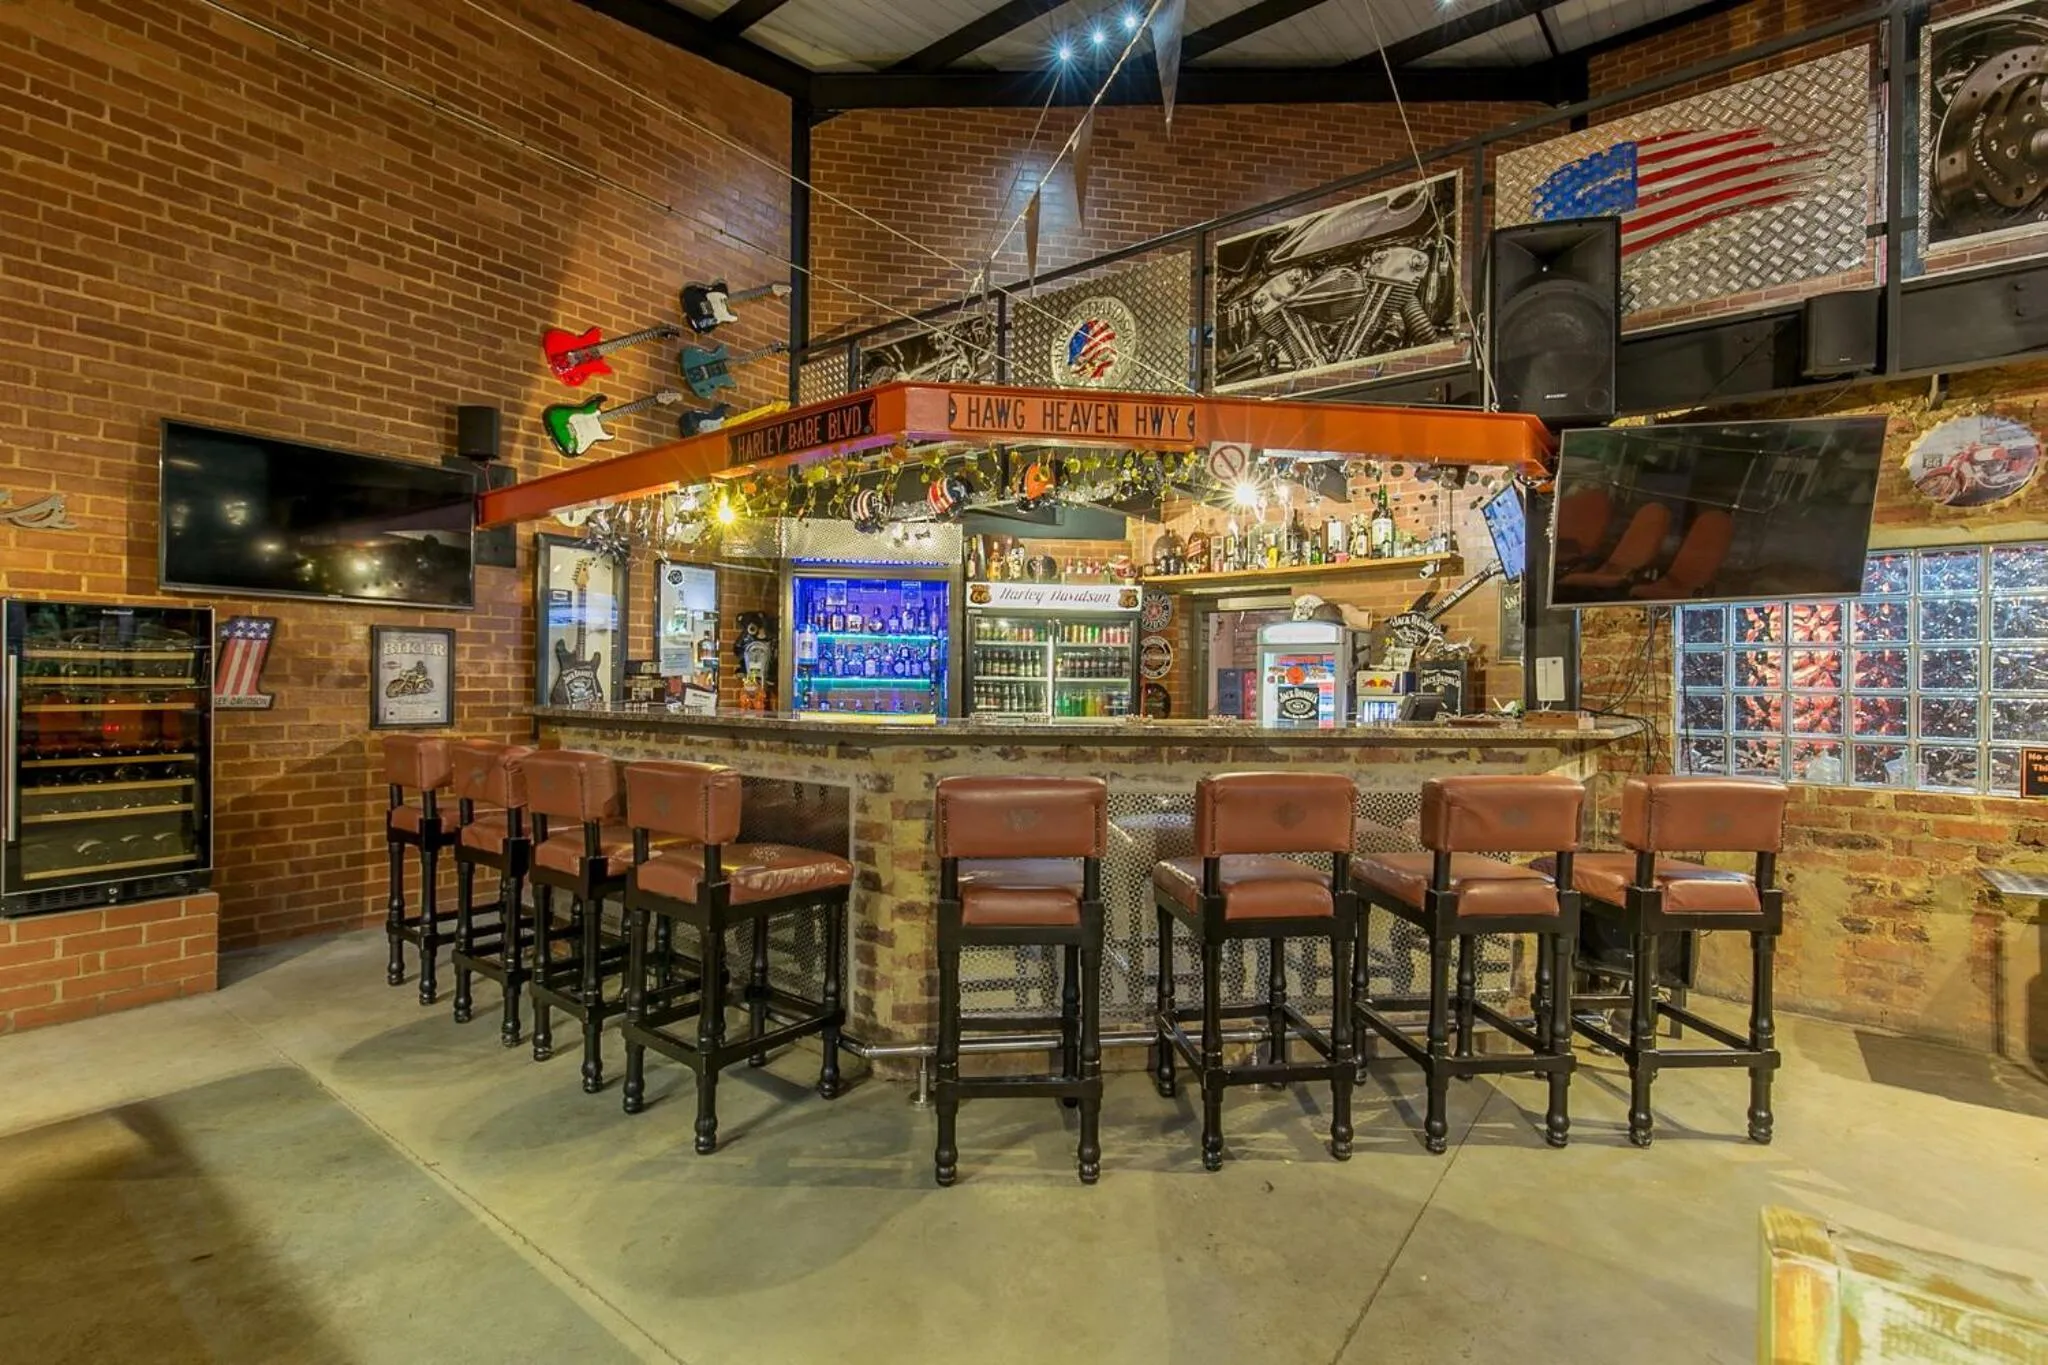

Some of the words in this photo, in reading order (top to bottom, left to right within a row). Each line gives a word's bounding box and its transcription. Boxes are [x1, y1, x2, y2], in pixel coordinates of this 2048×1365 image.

[967, 397, 1025, 430] HAWG
[1042, 400, 1119, 434] HEAVEN
[1135, 405, 1180, 437] HWY
[737, 425, 784, 462] HARLEY
[787, 414, 823, 450] BABE
[827, 405, 862, 442] BLVD
[999, 587, 1046, 605] Harley
[1050, 589, 1112, 603] Davidson
[383, 640, 445, 656] BIKER
